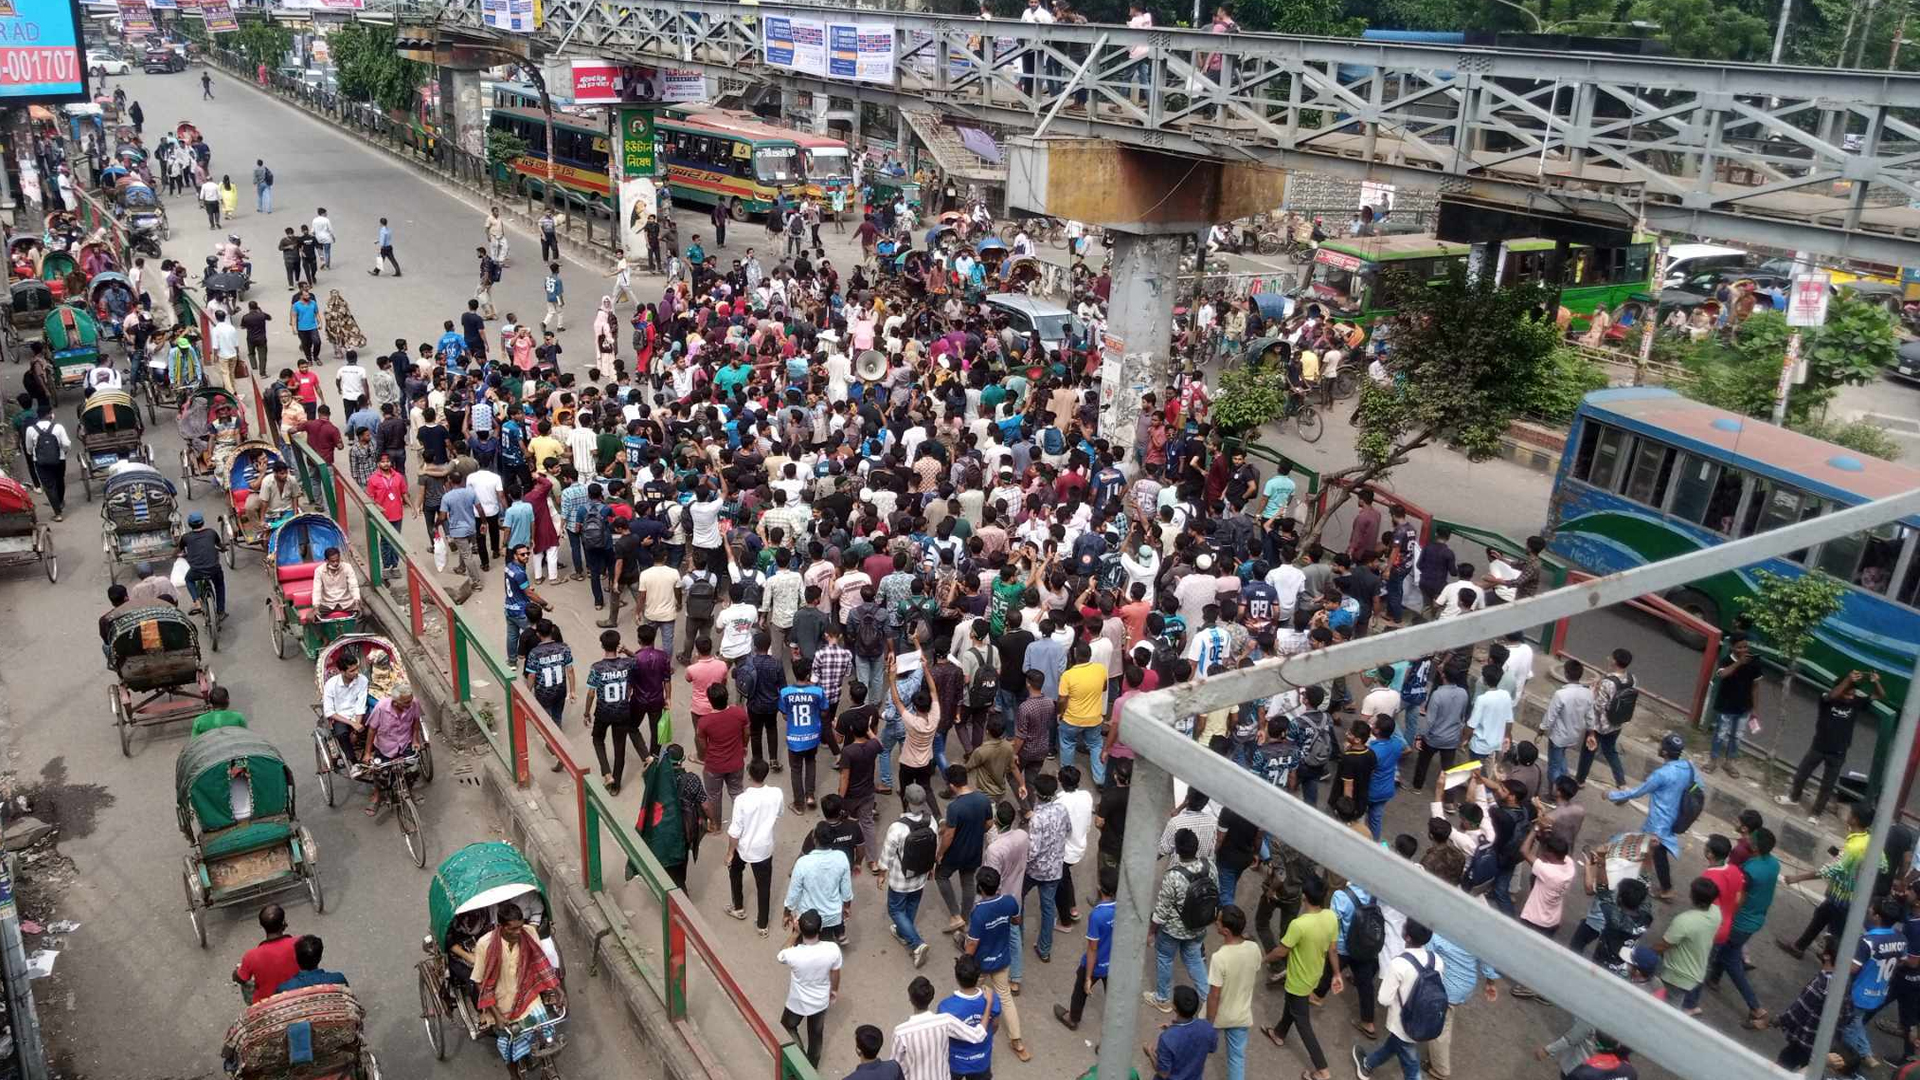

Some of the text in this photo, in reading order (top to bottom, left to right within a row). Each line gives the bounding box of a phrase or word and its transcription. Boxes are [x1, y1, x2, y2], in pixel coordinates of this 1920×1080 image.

[14, 22, 40, 41] AD
[626, 154, 652, 167] নিষেধ
[1250, 600, 1269, 618] 89
[541, 664, 563, 687] 11
[601, 669, 628, 681] ZIHAD
[604, 680, 627, 702] 01
[788, 694, 813, 703] RANA
[792, 704, 811, 727] 18
[1268, 755, 1292, 767] ALI
[1268, 768, 1289, 787] 74
[1876, 957, 1898, 983] 10
